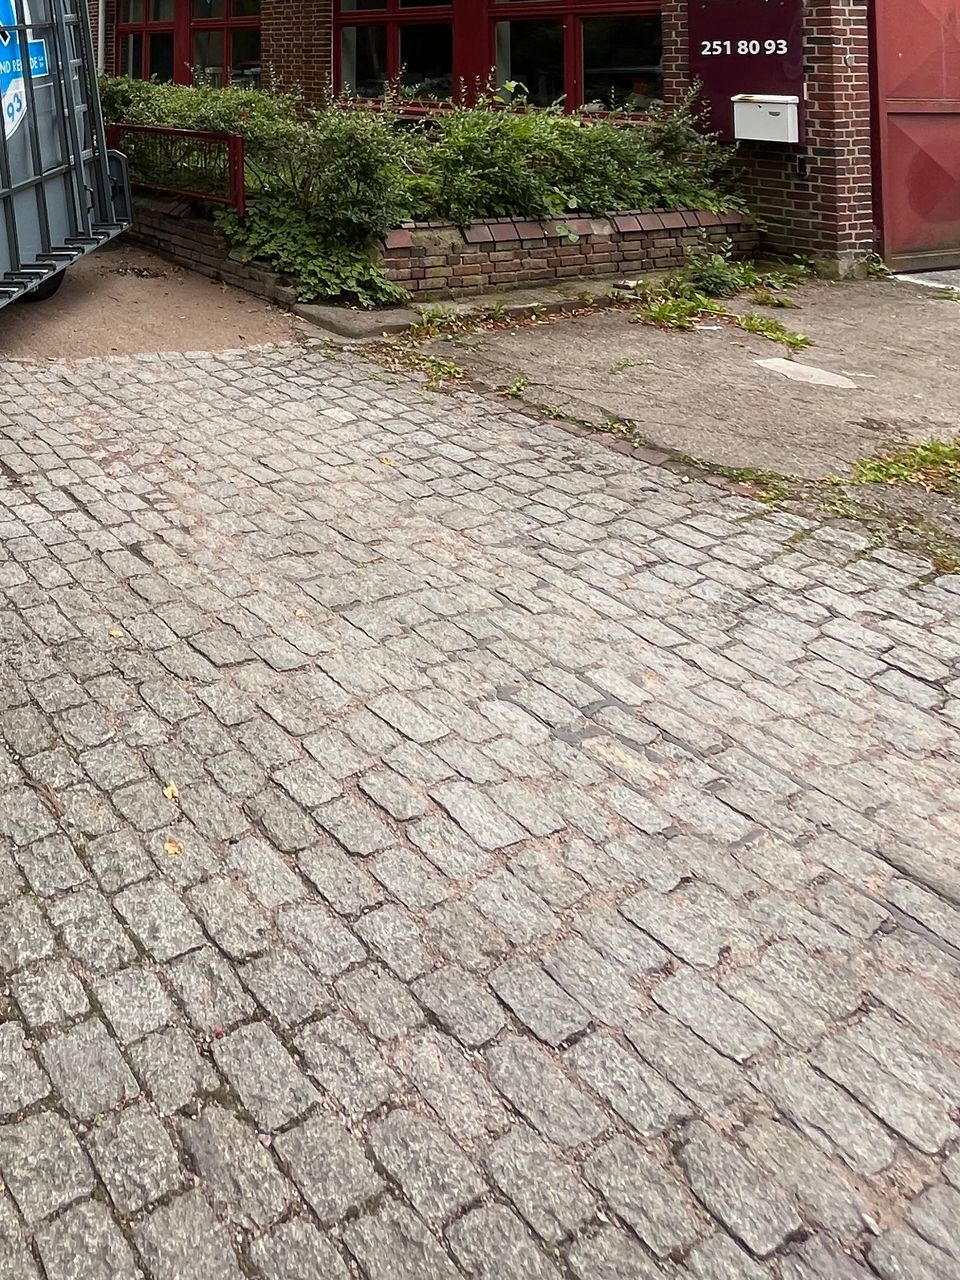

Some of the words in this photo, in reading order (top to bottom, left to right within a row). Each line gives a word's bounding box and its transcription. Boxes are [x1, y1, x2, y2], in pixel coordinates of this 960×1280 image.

[701, 40, 732, 55] 251
[737, 39, 761, 55] 80
[764, 39, 788, 55] 93
